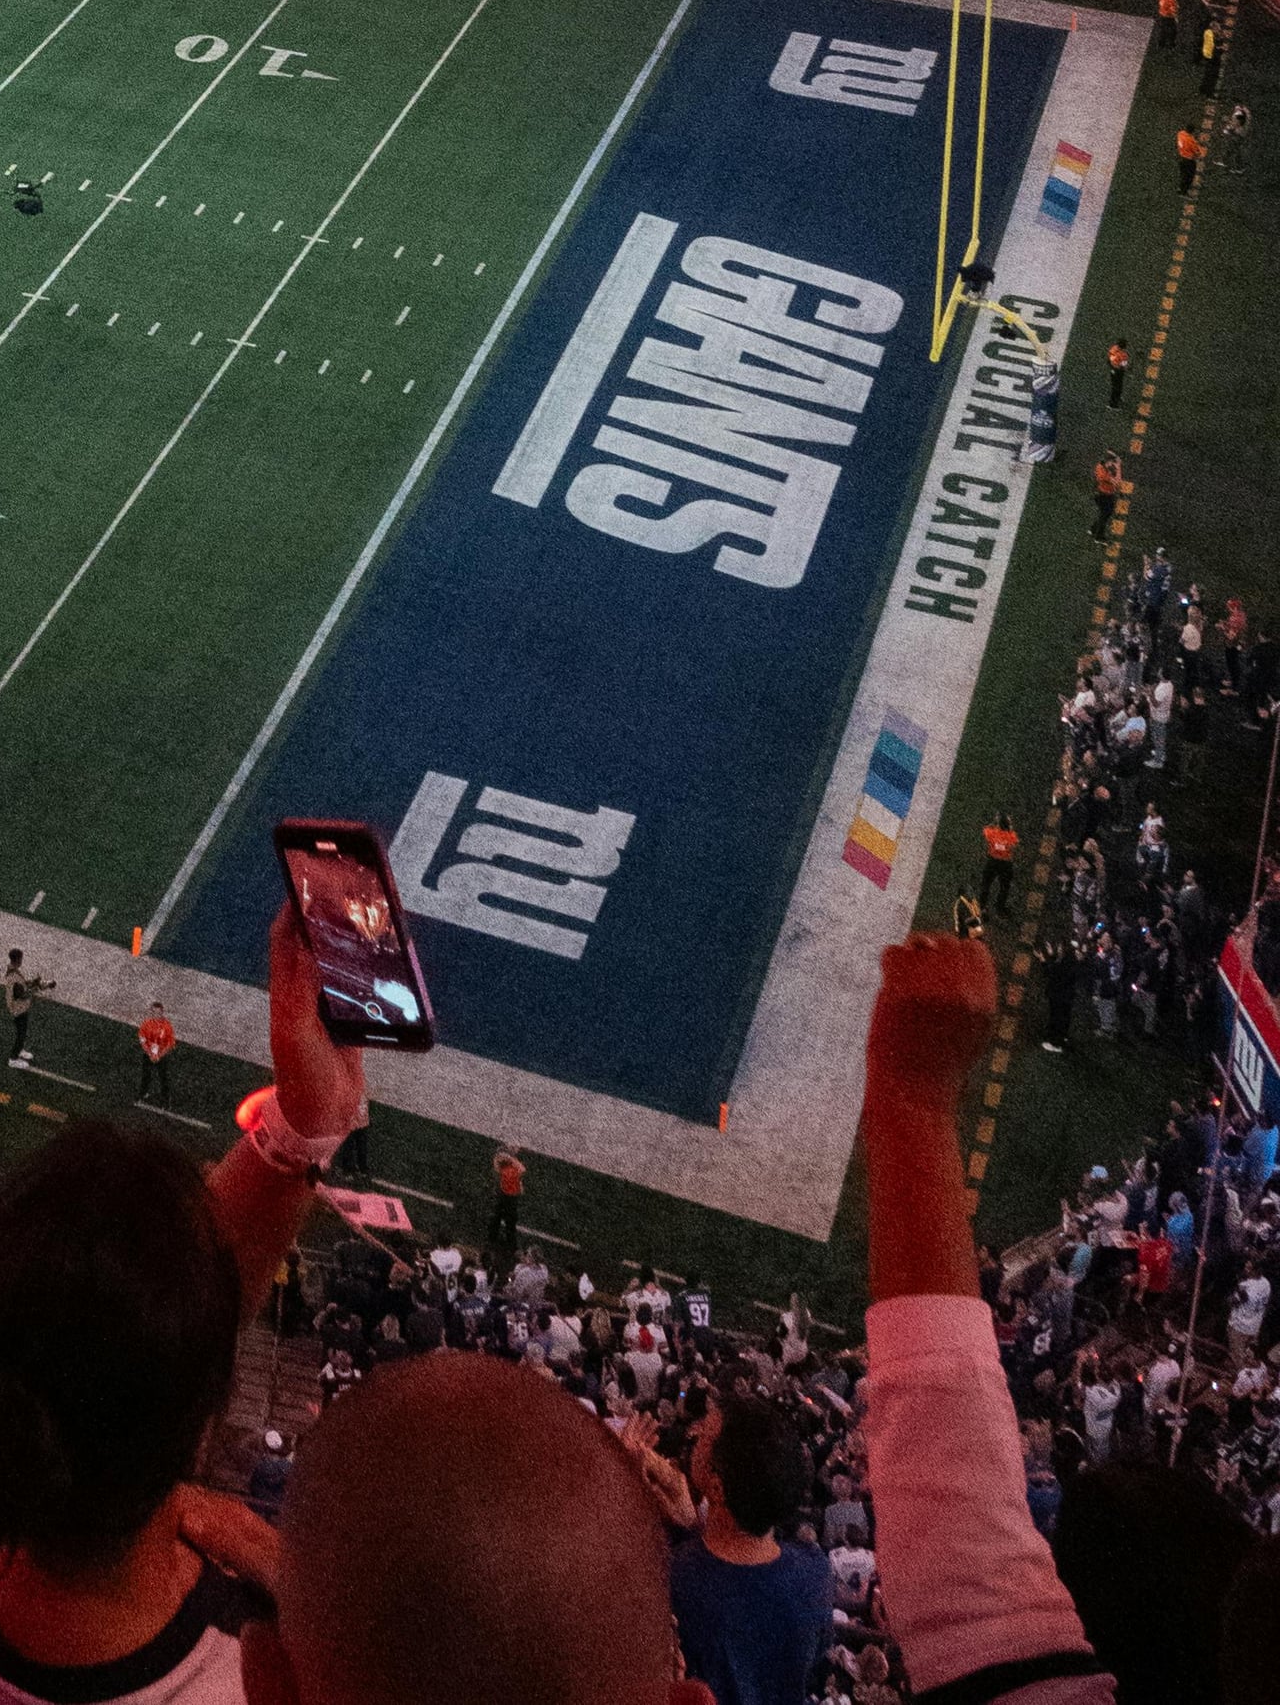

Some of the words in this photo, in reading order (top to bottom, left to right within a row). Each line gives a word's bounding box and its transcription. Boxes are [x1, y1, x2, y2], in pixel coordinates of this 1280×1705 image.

[174, 33, 308, 79] 10
[565, 235, 905, 589] GIANTS
[951, 293, 1060, 453] CRUCIAL
[903, 472, 1010, 624] CATCH
[689, 1302, 710, 1327] 97
